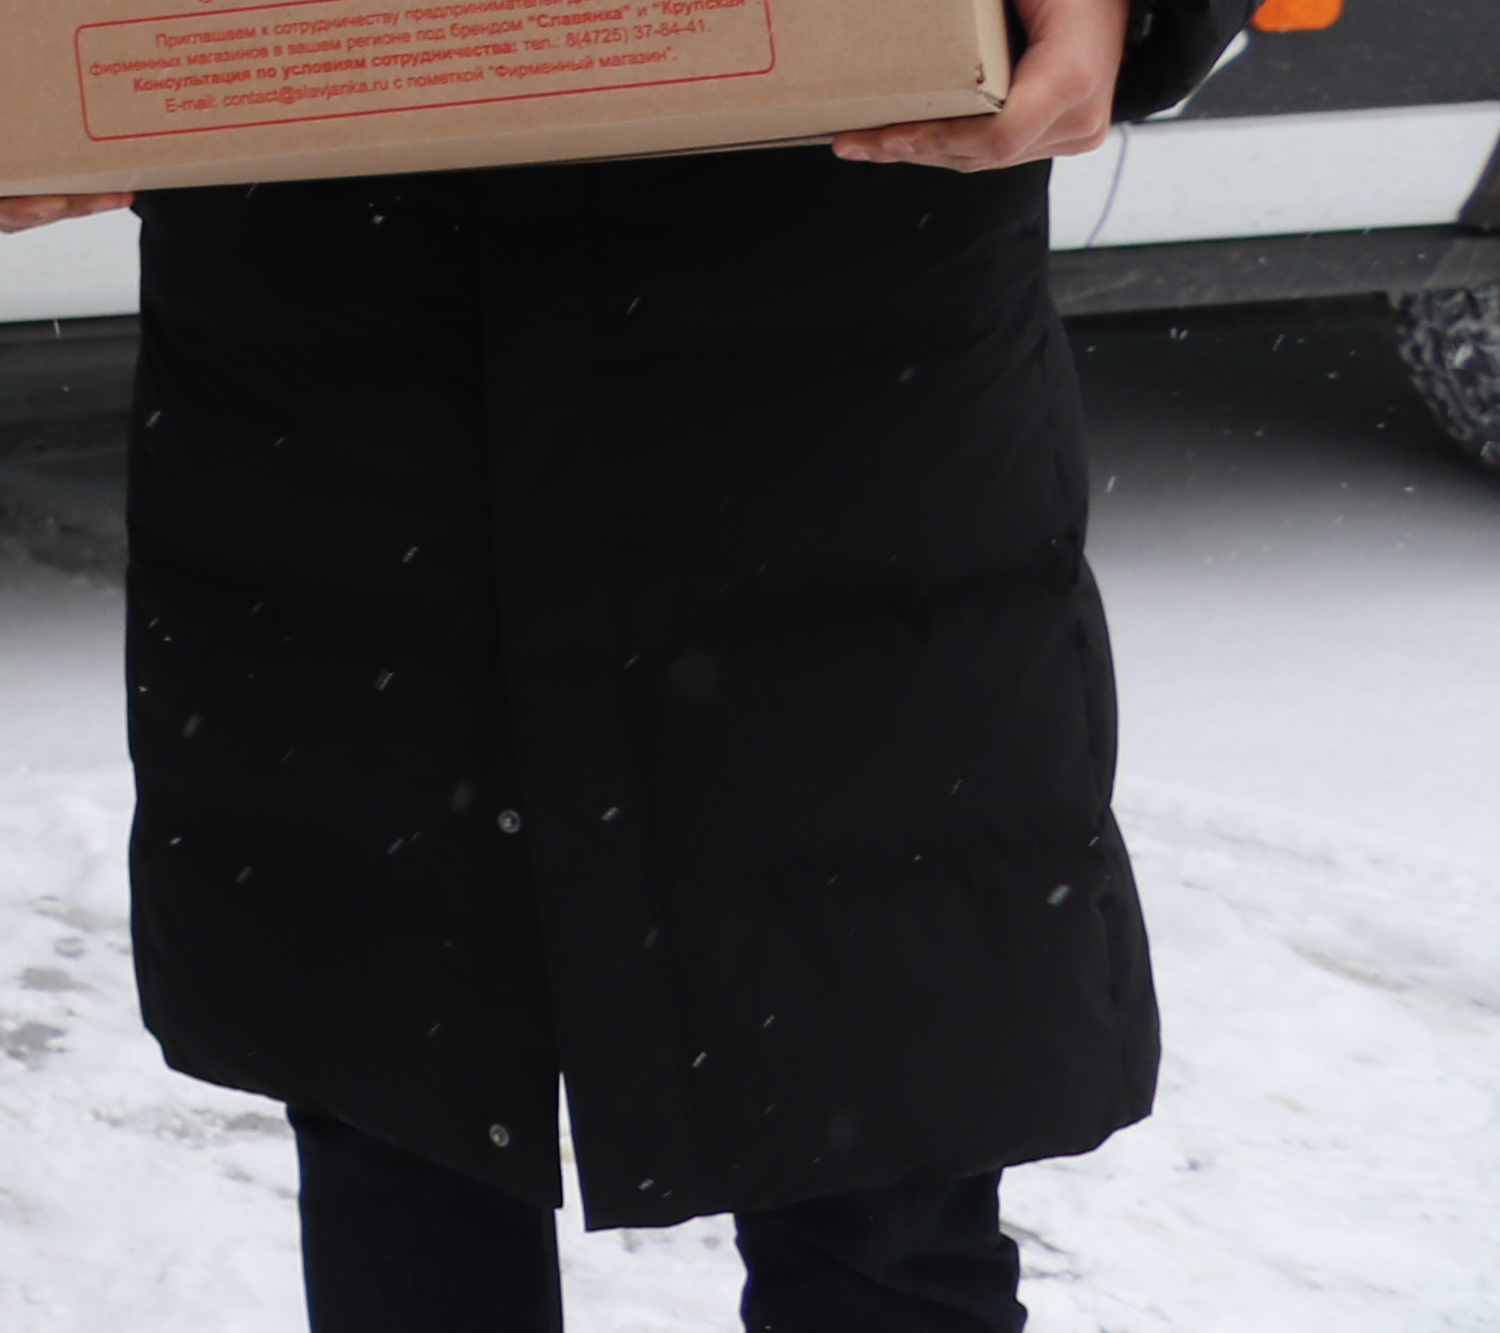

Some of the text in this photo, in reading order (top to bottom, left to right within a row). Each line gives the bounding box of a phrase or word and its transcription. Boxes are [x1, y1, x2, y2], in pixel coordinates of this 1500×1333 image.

[89, 55, 181, 77] фирменных
[187, 48, 268, 67] магазинов
[288, 39, 341, 55] вашем
[347, 31, 411, 52] регионе
[416, 26, 444, 43] под
[449, 16, 523, 39] брендом
[155, 26, 256, 48] Приглашаем
[274, 10, 400, 36] сотрудничеству
[133, 70, 250, 93] Консультация
[257, 67, 276, 80] по
[282, 56, 366, 80] условиям
[372, 41, 517, 70] сотрудничества:
[164, 96, 217, 113] E-mail:
[222, 78, 389, 108] contact@slavjanka.ru
[407, 67, 484, 89] пометкой
